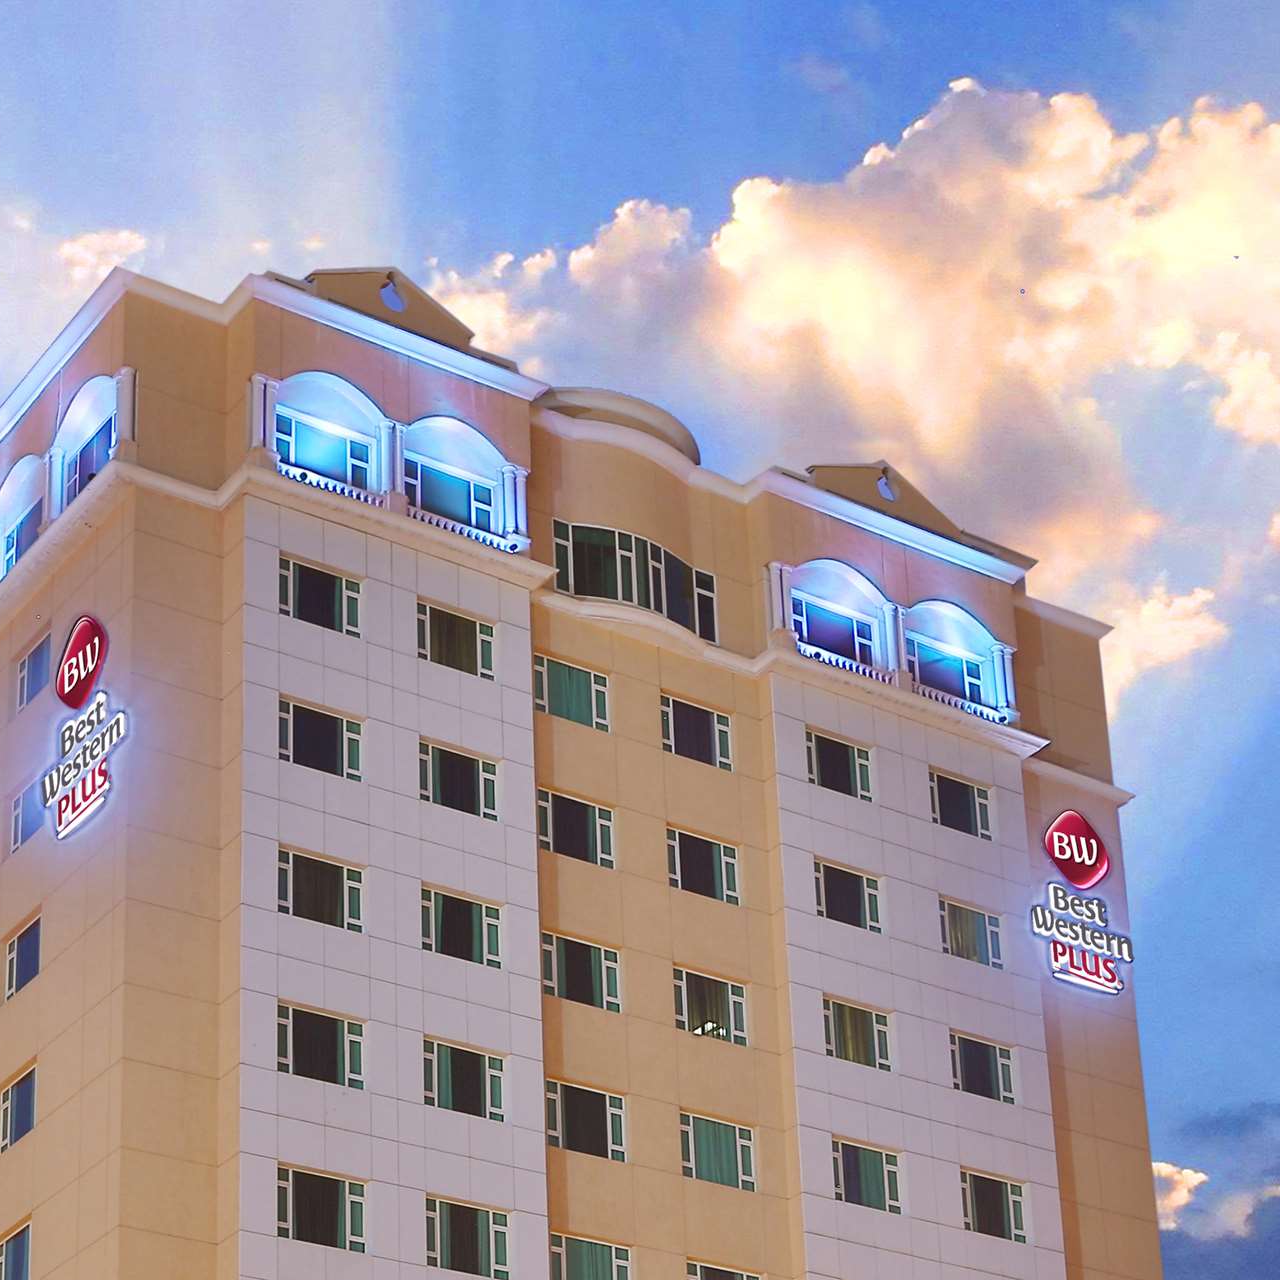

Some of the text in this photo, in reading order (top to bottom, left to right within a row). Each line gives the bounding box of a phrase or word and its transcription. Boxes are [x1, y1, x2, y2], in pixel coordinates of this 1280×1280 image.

[63, 636, 100, 694] BW
[60, 697, 105, 758] Best
[41, 715, 123, 801] Western
[57, 757, 109, 827] PLUS
[1052, 831, 1098, 866] BW
[1032, 905, 1134, 961] Western
[1052, 886, 1108, 926] Best
[1052, 941, 1118, 983] PLUS
